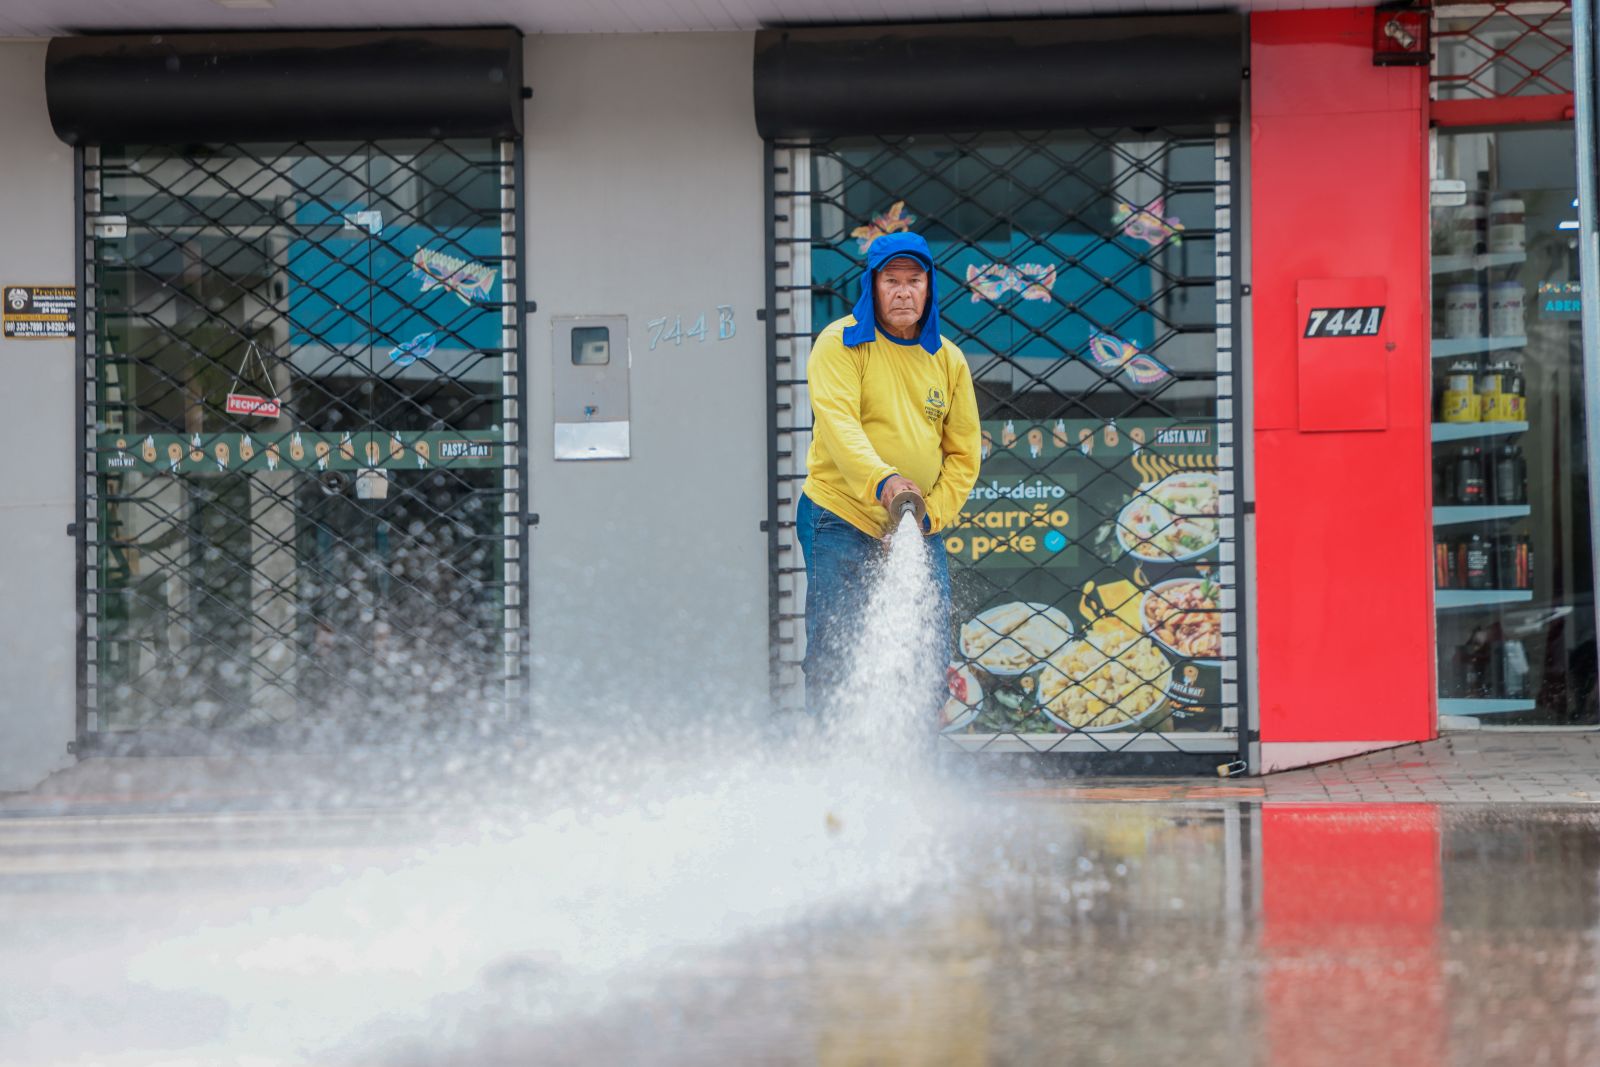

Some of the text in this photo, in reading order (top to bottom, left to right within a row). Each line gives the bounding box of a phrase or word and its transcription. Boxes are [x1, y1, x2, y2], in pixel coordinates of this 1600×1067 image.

[1307, 307, 1380, 336] 744A
[230, 400, 277, 412] FECHADO
[1157, 429, 1207, 443] PASTA WAY
[442, 442, 468, 457] PASTA
[946, 503, 1070, 529] acarrão
[971, 531, 1037, 560] pote
